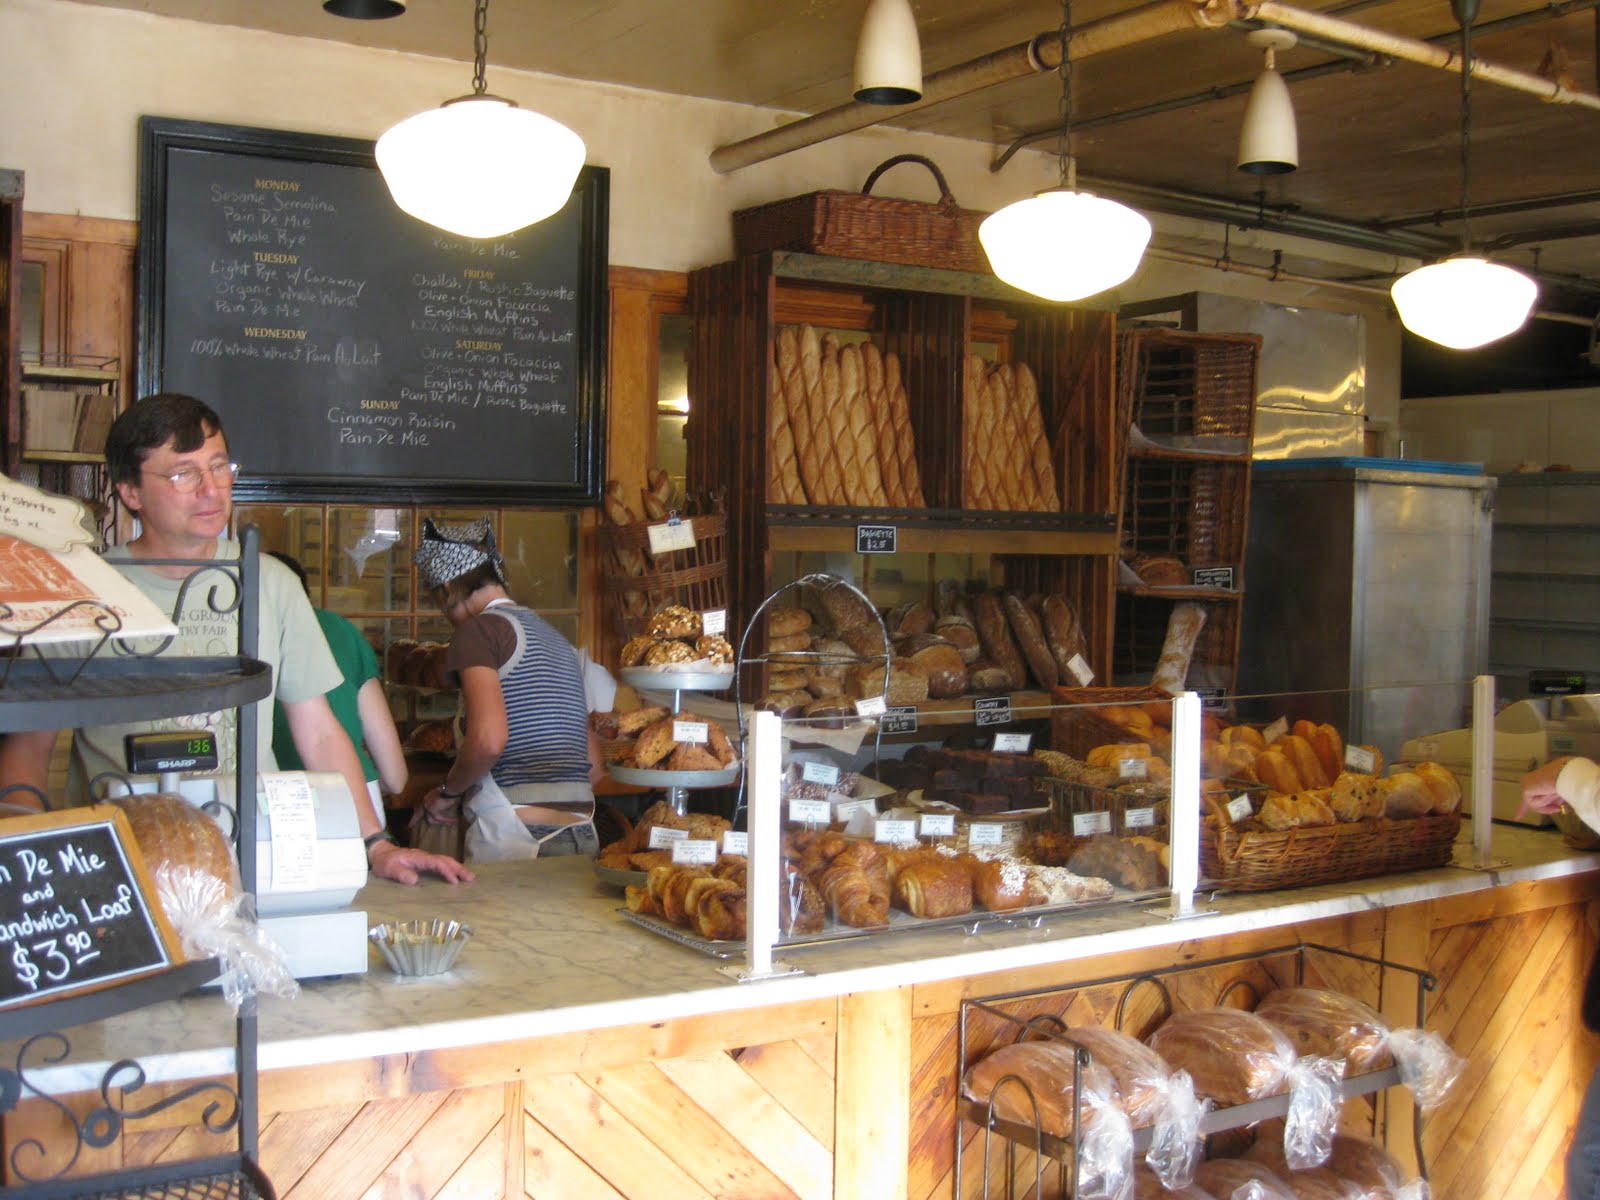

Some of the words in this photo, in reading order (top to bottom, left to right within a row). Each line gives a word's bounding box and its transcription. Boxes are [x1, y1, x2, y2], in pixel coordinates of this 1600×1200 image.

[255, 179, 301, 192] MONDAY
[210, 184, 265, 204] Sesame
[273, 192, 337, 213] Semolina
[223, 206, 255, 222] Pain
[261, 208, 278, 225] De
[285, 214, 312, 228] Mie
[227, 228, 270, 245] Whole
[277, 228, 307, 249] Rye
[253, 251, 300, 264] TUESDAY
[494, 241, 520, 259] Mie
[210, 259, 251, 281] Light
[255, 263, 279, 281] Rye
[304, 267, 366, 296] Caraway
[463, 269, 496, 280] FRIDAY
[522, 281, 577, 300] Baguette
[215, 299, 245, 313] Pain
[250, 298, 268, 316] De
[424, 305, 478, 321] English
[485, 309, 539, 327] Muffins
[244, 327, 308, 340] WEDNESDAY
[190, 337, 223, 357] 100%
[304, 343, 331, 365] Pain
[352, 343, 382, 366] Lait
[455, 339, 504, 351] SATURDAY
[421, 346, 455, 360] Olive
[464, 351, 500, 365] Onion
[504, 353, 562, 370] Focaccia
[423, 375, 473, 393] English
[478, 379, 528, 395] Muffins
[519, 370, 559, 384] Wheat
[360, 399, 400, 410] SUNDAY
[401, 387, 428, 401] Pain
[520, 398, 568, 416] Baguette
[327, 406, 403, 427] Cinnamon
[408, 411, 457, 431] Raisin
[340, 428, 373, 444] Pain
[376, 428, 395, 444] De
[401, 430, 430, 447] Mie
[203, 624, 227, 636] FAIR
[157, 759, 197, 769] SHARP
[17, 849, 53, 882] De
[58, 843, 106, 874] Mie
[22, 882, 54, 904] and
[0, 904, 78, 942] andwich
[81, 884, 132, 923] Loaf
